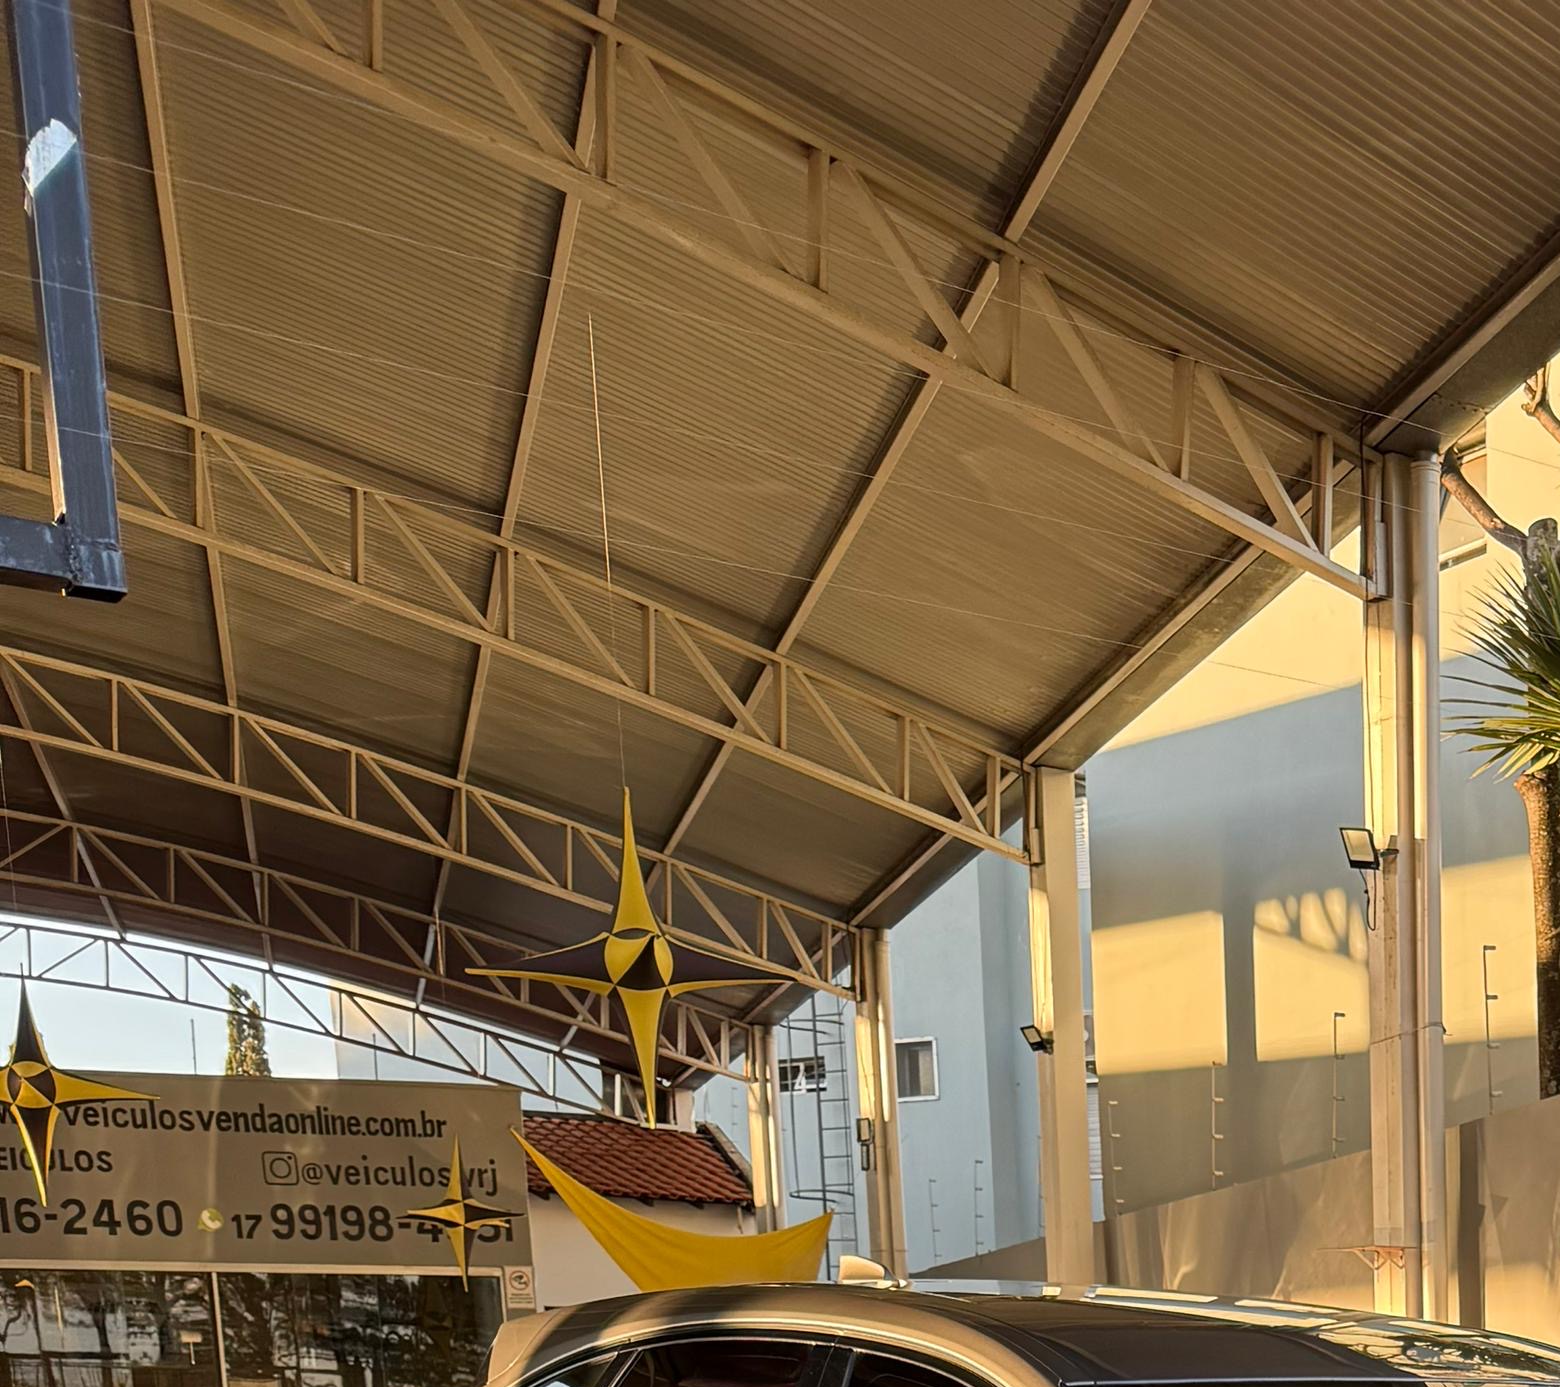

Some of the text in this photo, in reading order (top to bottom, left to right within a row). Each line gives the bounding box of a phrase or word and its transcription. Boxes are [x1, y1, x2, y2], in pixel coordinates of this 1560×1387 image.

[0, 1100, 448, 1139] veiculosvendaonline.com.br
[231, 1203, 514, 1243] 17 99198-41
